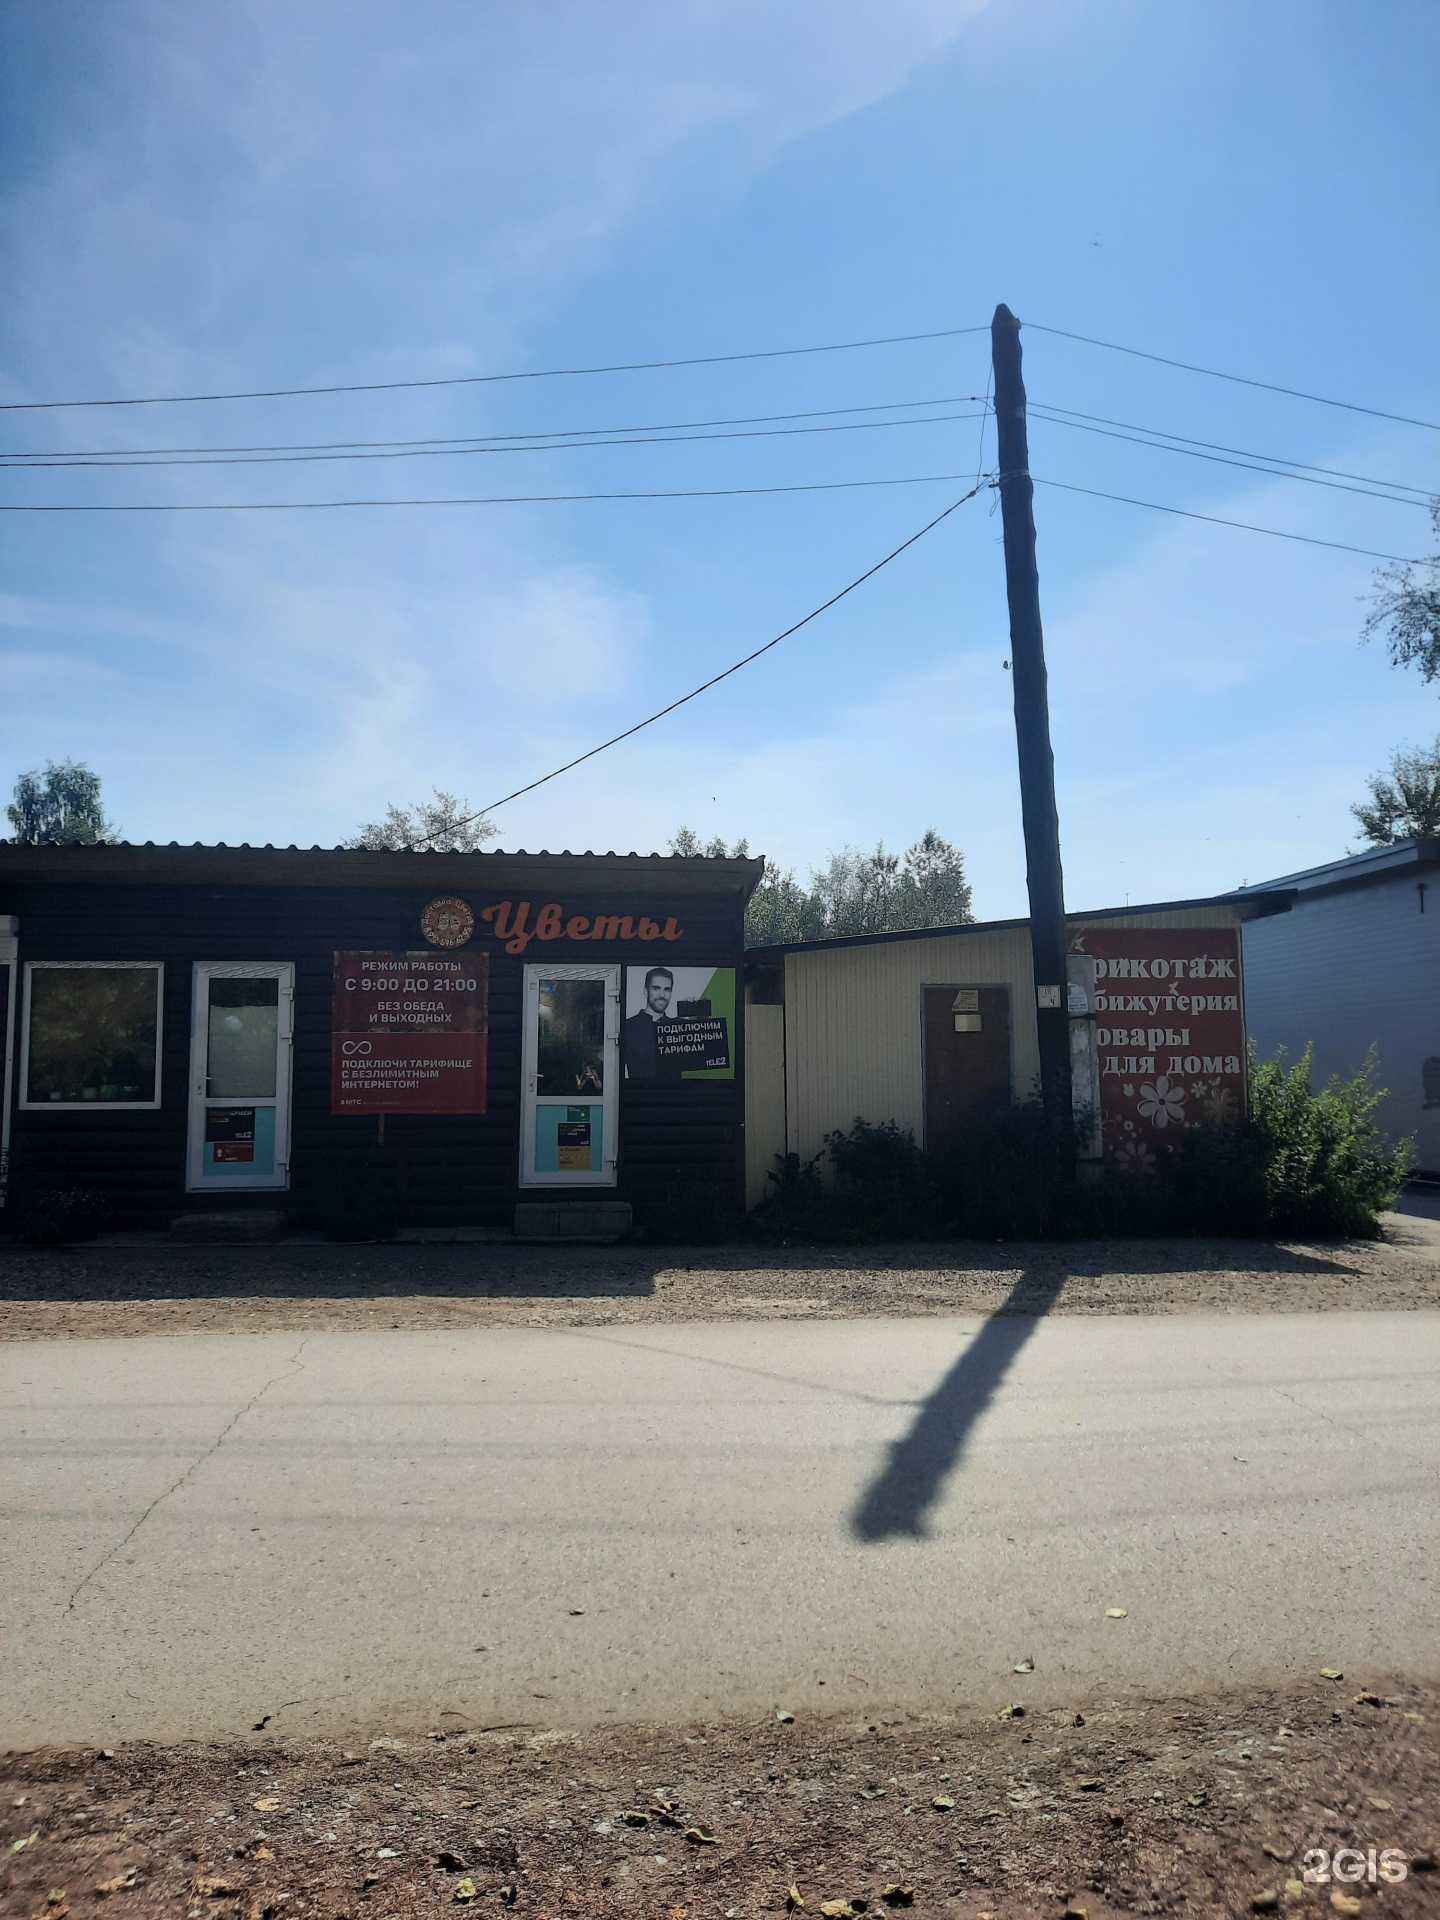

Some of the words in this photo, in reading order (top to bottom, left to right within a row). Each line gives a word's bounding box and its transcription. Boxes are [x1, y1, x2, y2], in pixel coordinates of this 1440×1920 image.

[481, 901, 684, 954] Цветы
[361, 961, 409, 971] РЕЖИМ
[411, 961, 461, 971] РАБОТЫ
[1095, 958, 1237, 984] рикотаж
[345, 978, 357, 991] С
[361, 978, 399, 991] 9:00
[403, 978, 429, 993] ДО
[433, 978, 477, 991] 21:00
[378, 1001, 400, 1011] БЕЗ
[403, 1001, 445, 1012] ОБЕДА
[369, 1013, 378, 1023] И
[381, 1013, 452, 1024] ВЫХОДНЫХ
[657, 1022, 721, 1034] ПОДКЛЮЧИМ
[657, 1036, 664, 1044] К
[666, 1032, 723, 1043] ВЫГОДНЫМ
[1097, 1028, 1191, 1052] овары
[659, 1044, 705, 1055] ТАРИФАМ
[341, 1060, 407, 1069] ПОДКЛЮЧИ
[410, 1060, 473, 1069] ТАРИФИЩЕ
[705, 1057, 727, 1067] TELE2
[1103, 1056, 1156, 1077] для
[1166, 1056, 1241, 1077] дома
[341, 1070, 349, 1079] С
[351, 1070, 439, 1079] БЕЗЛИМИТНЫМ
[341, 1080, 419, 1089] ИНТЕРНЕТОМ!
